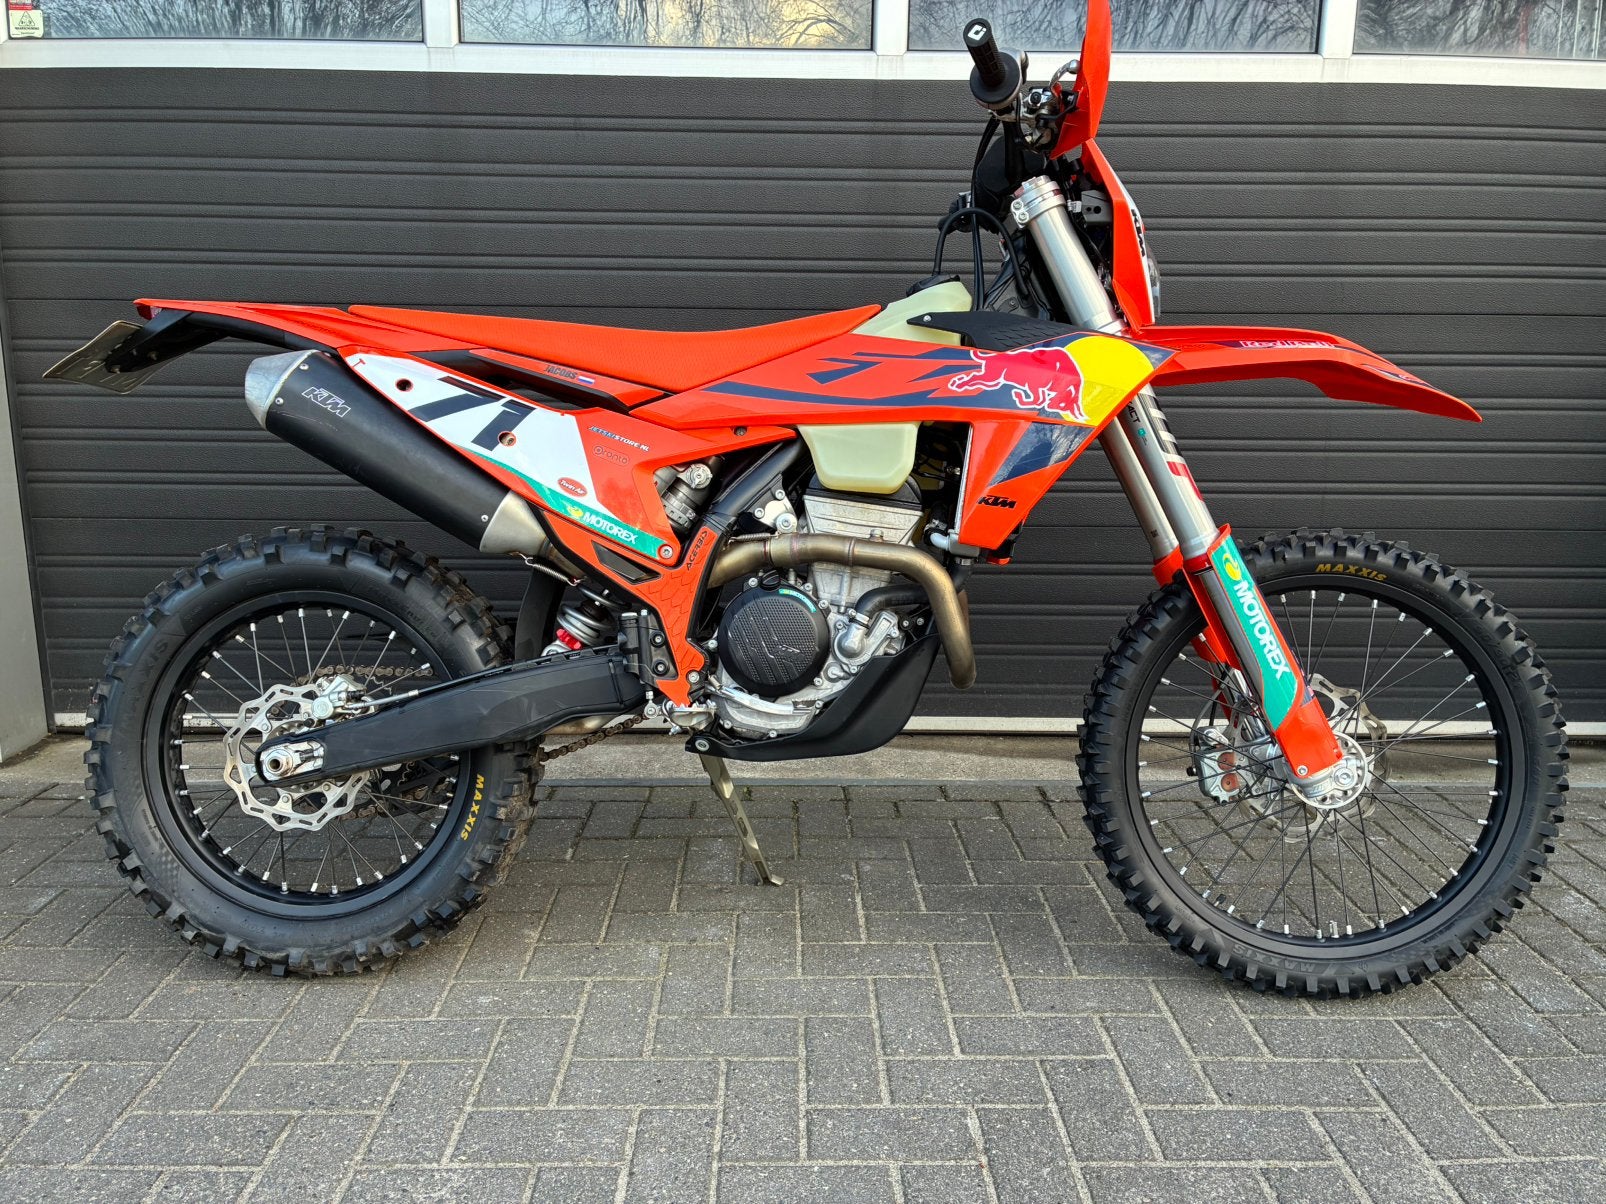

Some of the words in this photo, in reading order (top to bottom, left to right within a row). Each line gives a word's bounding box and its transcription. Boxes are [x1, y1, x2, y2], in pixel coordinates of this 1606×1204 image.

[544, 365, 577, 379] JACOBS
[301, 386, 351, 417] KTM
[977, 495, 1016, 508] KTM
[583, 511, 638, 545] MOTOREX
[686, 530, 708, 571] ACERBIS
[1316, 563, 1388, 580] MAXXIS
[1234, 580, 1291, 680] MOTOREX
[461, 773, 485, 840] MAXXIS
[1232, 943, 1315, 973] MAXXIS
